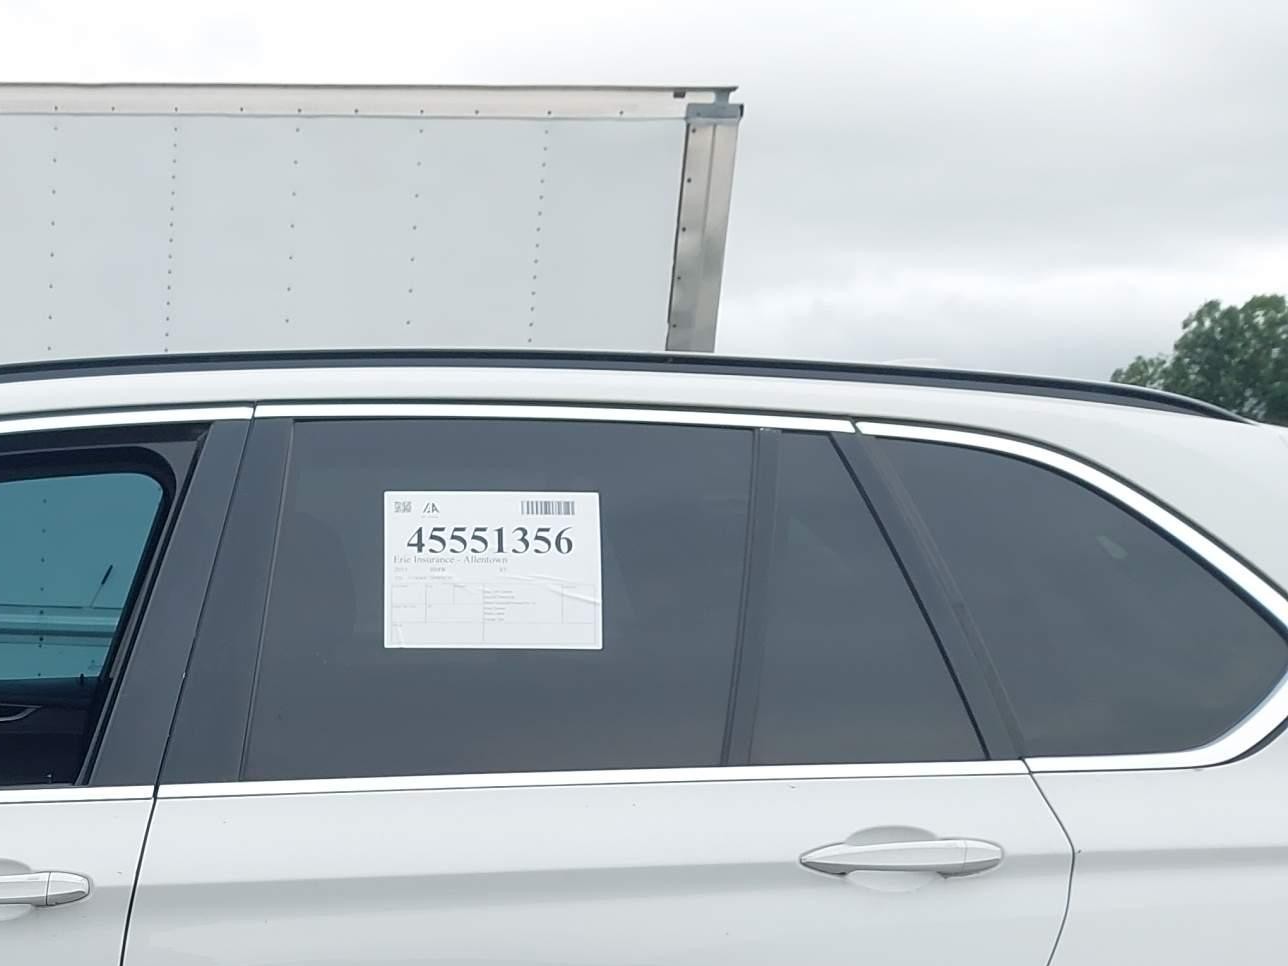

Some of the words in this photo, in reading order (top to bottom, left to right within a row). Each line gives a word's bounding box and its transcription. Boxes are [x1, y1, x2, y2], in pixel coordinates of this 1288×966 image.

[406, 527, 574, 554] 45551356
[393, 556, 411, 564] Erie
[414, 556, 454, 564] Insurance
[464, 556, 508, 564] Allentown
